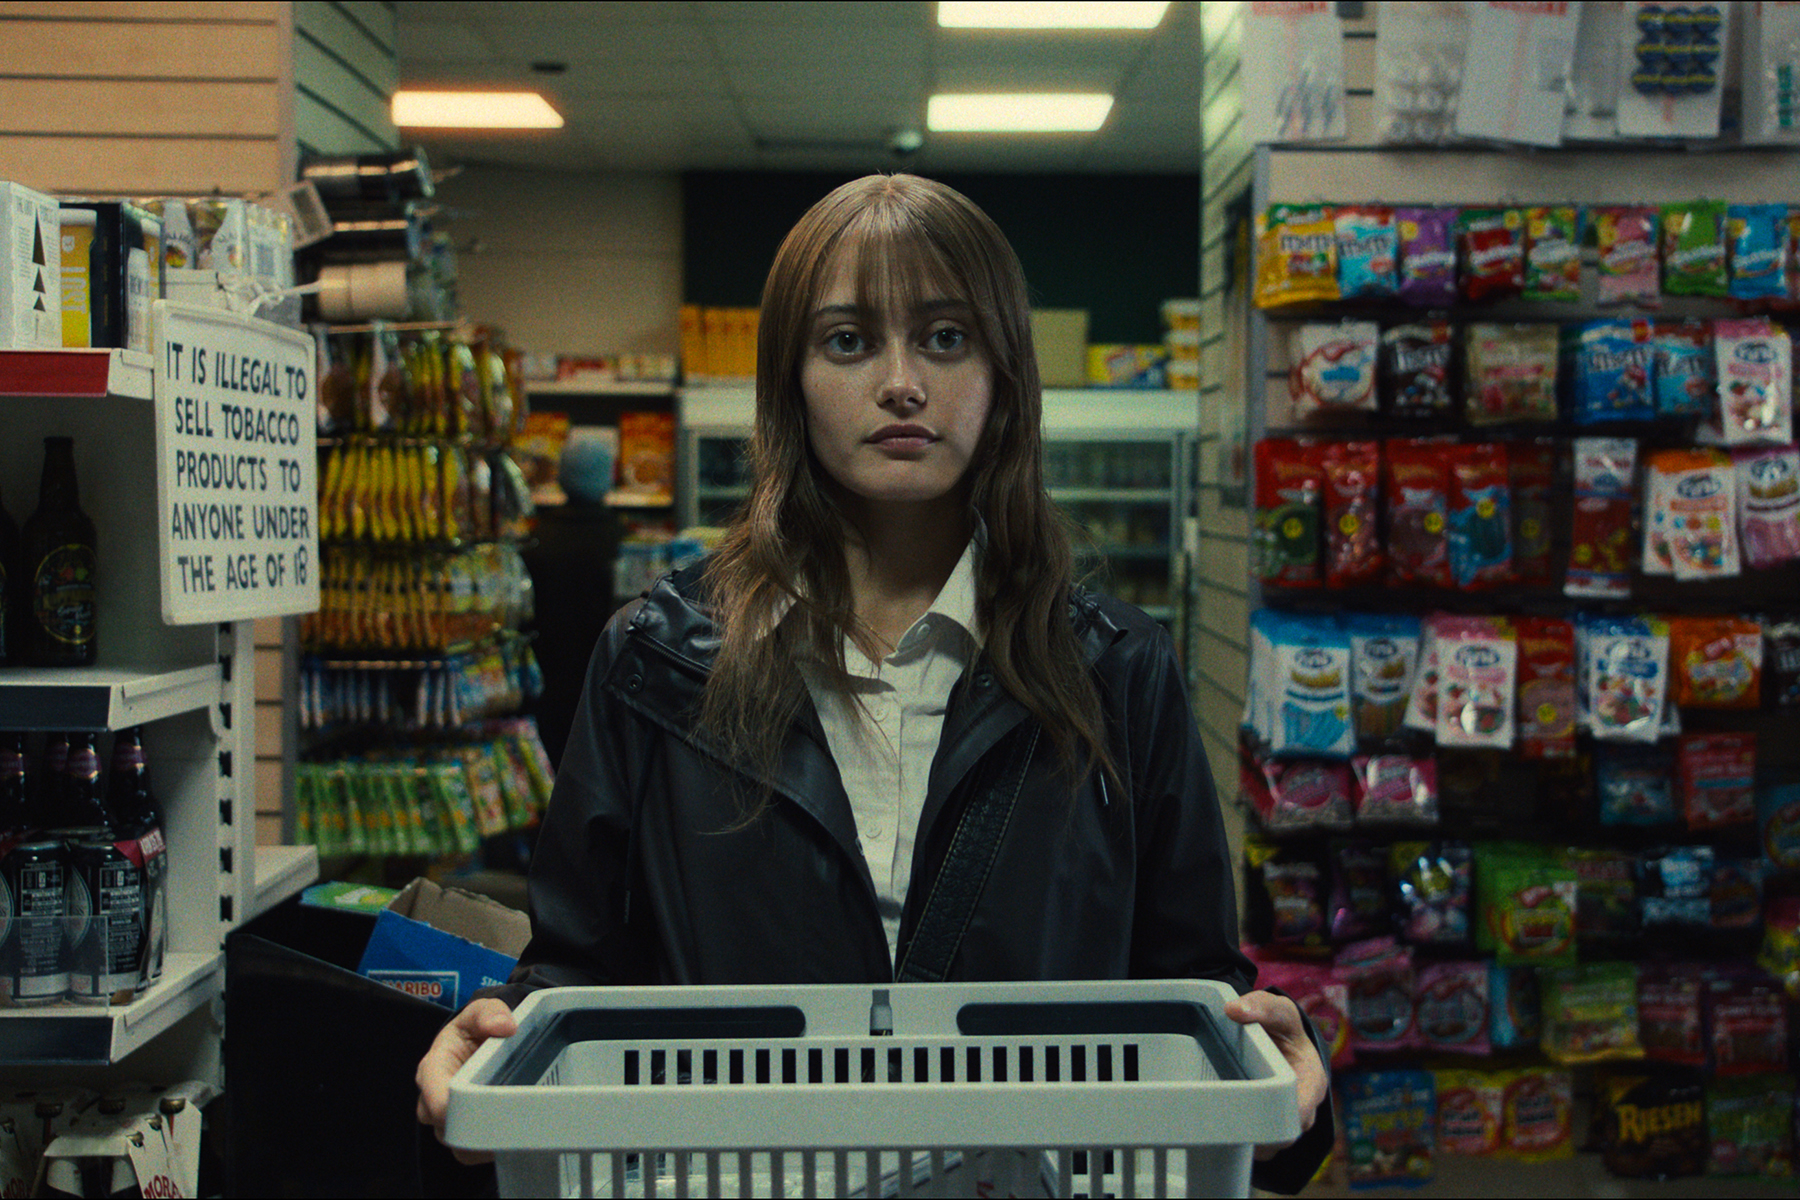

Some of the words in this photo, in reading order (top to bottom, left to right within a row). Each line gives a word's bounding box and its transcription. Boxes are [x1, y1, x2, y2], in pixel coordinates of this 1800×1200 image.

[167, 341, 183, 380] IT
[192, 347, 206, 384] IS
[215, 351, 280, 396] ILLEGAL
[285, 365, 306, 400] TO
[175, 397, 213, 437] SELL
[221, 403, 299, 445] TOBACCO
[176, 449, 267, 491] PRODUCTS
[279, 458, 300, 492] TO
[172, 502, 245, 540] ANYONE
[253, 505, 310, 539] UNDER
[178, 555, 215, 593] THE
[227, 553, 258, 590] AGE
[266, 552, 285, 587] OF
[294, 544, 308, 586] 18
[143, 1175, 183, 1198] MORE
